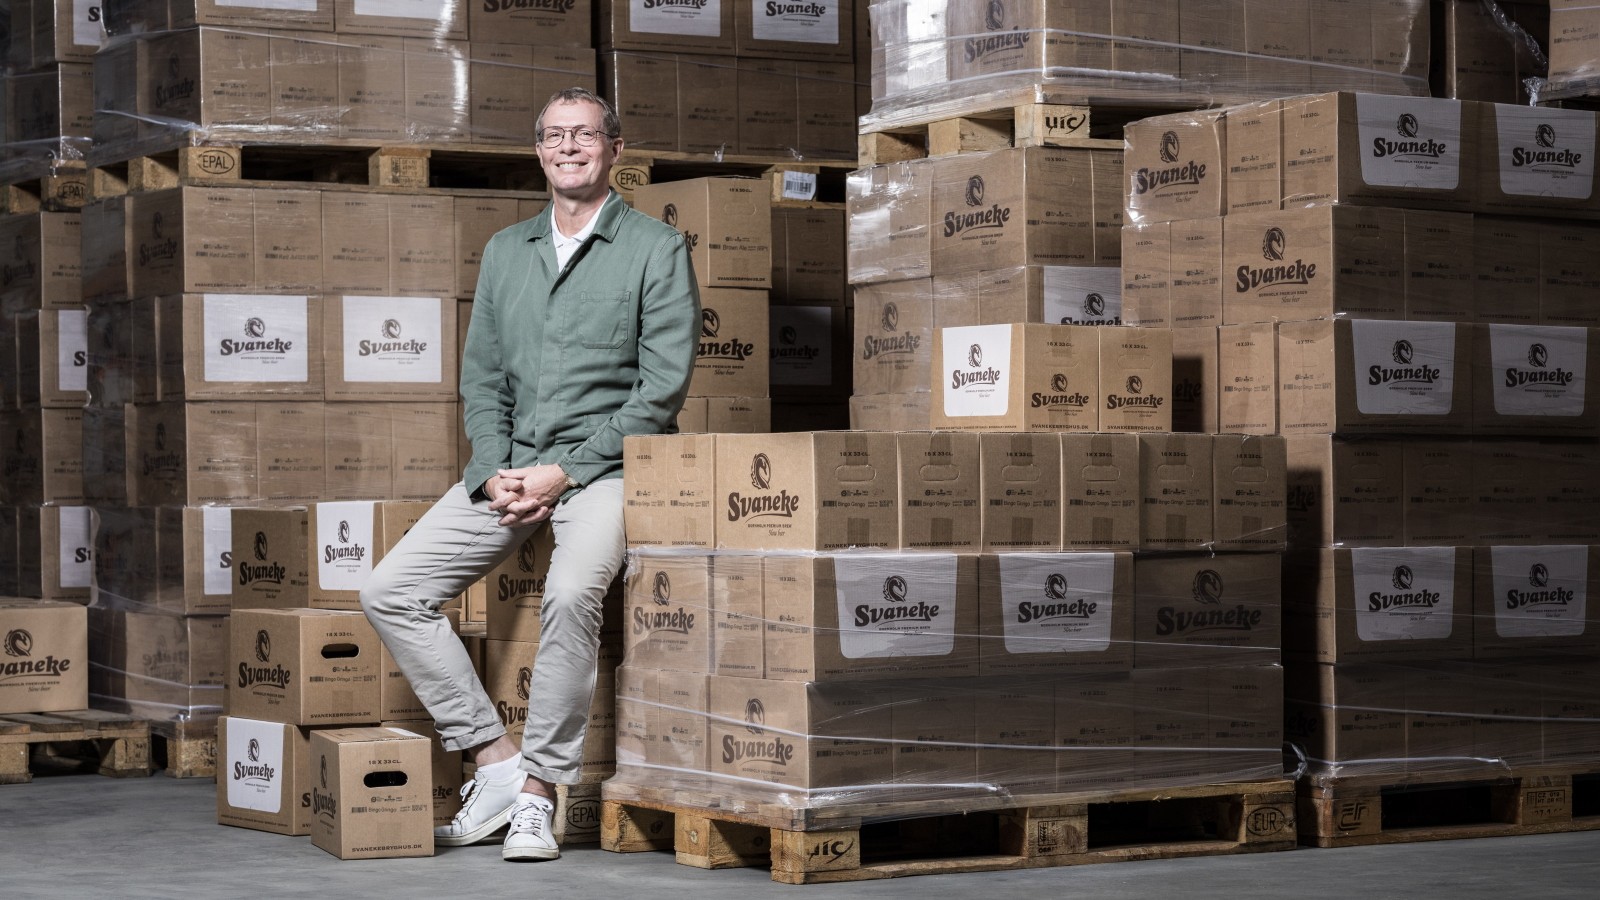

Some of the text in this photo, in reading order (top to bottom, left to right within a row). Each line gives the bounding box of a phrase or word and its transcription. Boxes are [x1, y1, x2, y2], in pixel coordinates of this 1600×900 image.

[766, 1, 826, 17] Svaneke
[964, 26, 1030, 63] Svaneke
[1374, 138, 1446, 158] Svaneke
[1512, 148, 1581, 167] Svaneke
[203, 155, 229, 170] EPAL
[621, 174, 644, 185] EPAL
[1136, 160, 1206, 194] Svaneke
[944, 204, 1010, 237] Svaneke
[1236, 260, 1316, 293] Svaneke
[220, 338, 292, 356] Svaneke
[359, 339, 428, 357] Svaneke
[697, 338, 754, 360] aneke
[770, 345, 819, 360] vaneke
[863, 331, 920, 360] Svaneke
[952, 367, 1000, 390] Svaneke
[1369, 364, 1440, 386] Svaneke
[1506, 368, 1572, 388] Svaneke
[1032, 392, 1090, 408] Svaneke
[1107, 394, 1164, 410] Svaneke
[728, 490, 799, 522] Svaneke
[324, 544, 364, 564] Svaneke
[240, 562, 286, 586] Svaneke
[498, 574, 548, 601] Svane
[1369, 590, 1440, 612] Svaneke
[1506, 588, 1574, 610] Svaneke
[633, 608, 694, 635] Svaneke
[854, 600, 939, 627] Svaneke
[1018, 599, 1096, 624] Svaneke
[1156, 604, 1262, 636] Svaneke
[238, 662, 290, 689] Svaneke
[722, 730, 793, 766] Svaneke
[234, 760, 274, 781] Svaneke
[313, 786, 336, 819] Svaneke
[572, 806, 600, 822] EPAL
[1254, 812, 1276, 831] EUR
[352, 844, 422, 852] SVANEKEBRYGHUS.DK
